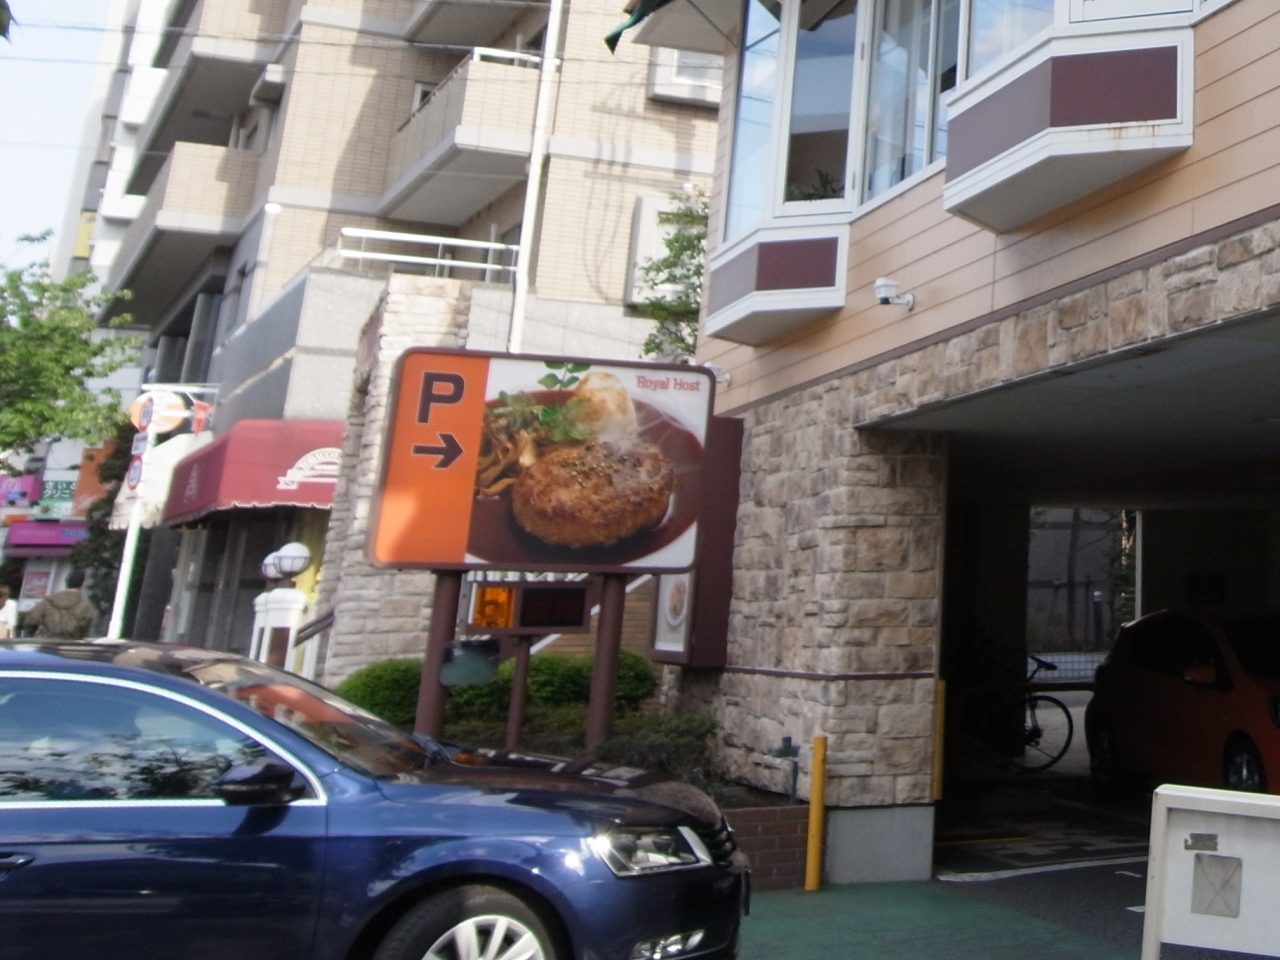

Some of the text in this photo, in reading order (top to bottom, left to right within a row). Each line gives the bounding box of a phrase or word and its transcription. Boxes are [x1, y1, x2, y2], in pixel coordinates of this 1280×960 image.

[417, 372, 465, 424] P
[637, 376, 701, 391] Royal Host
